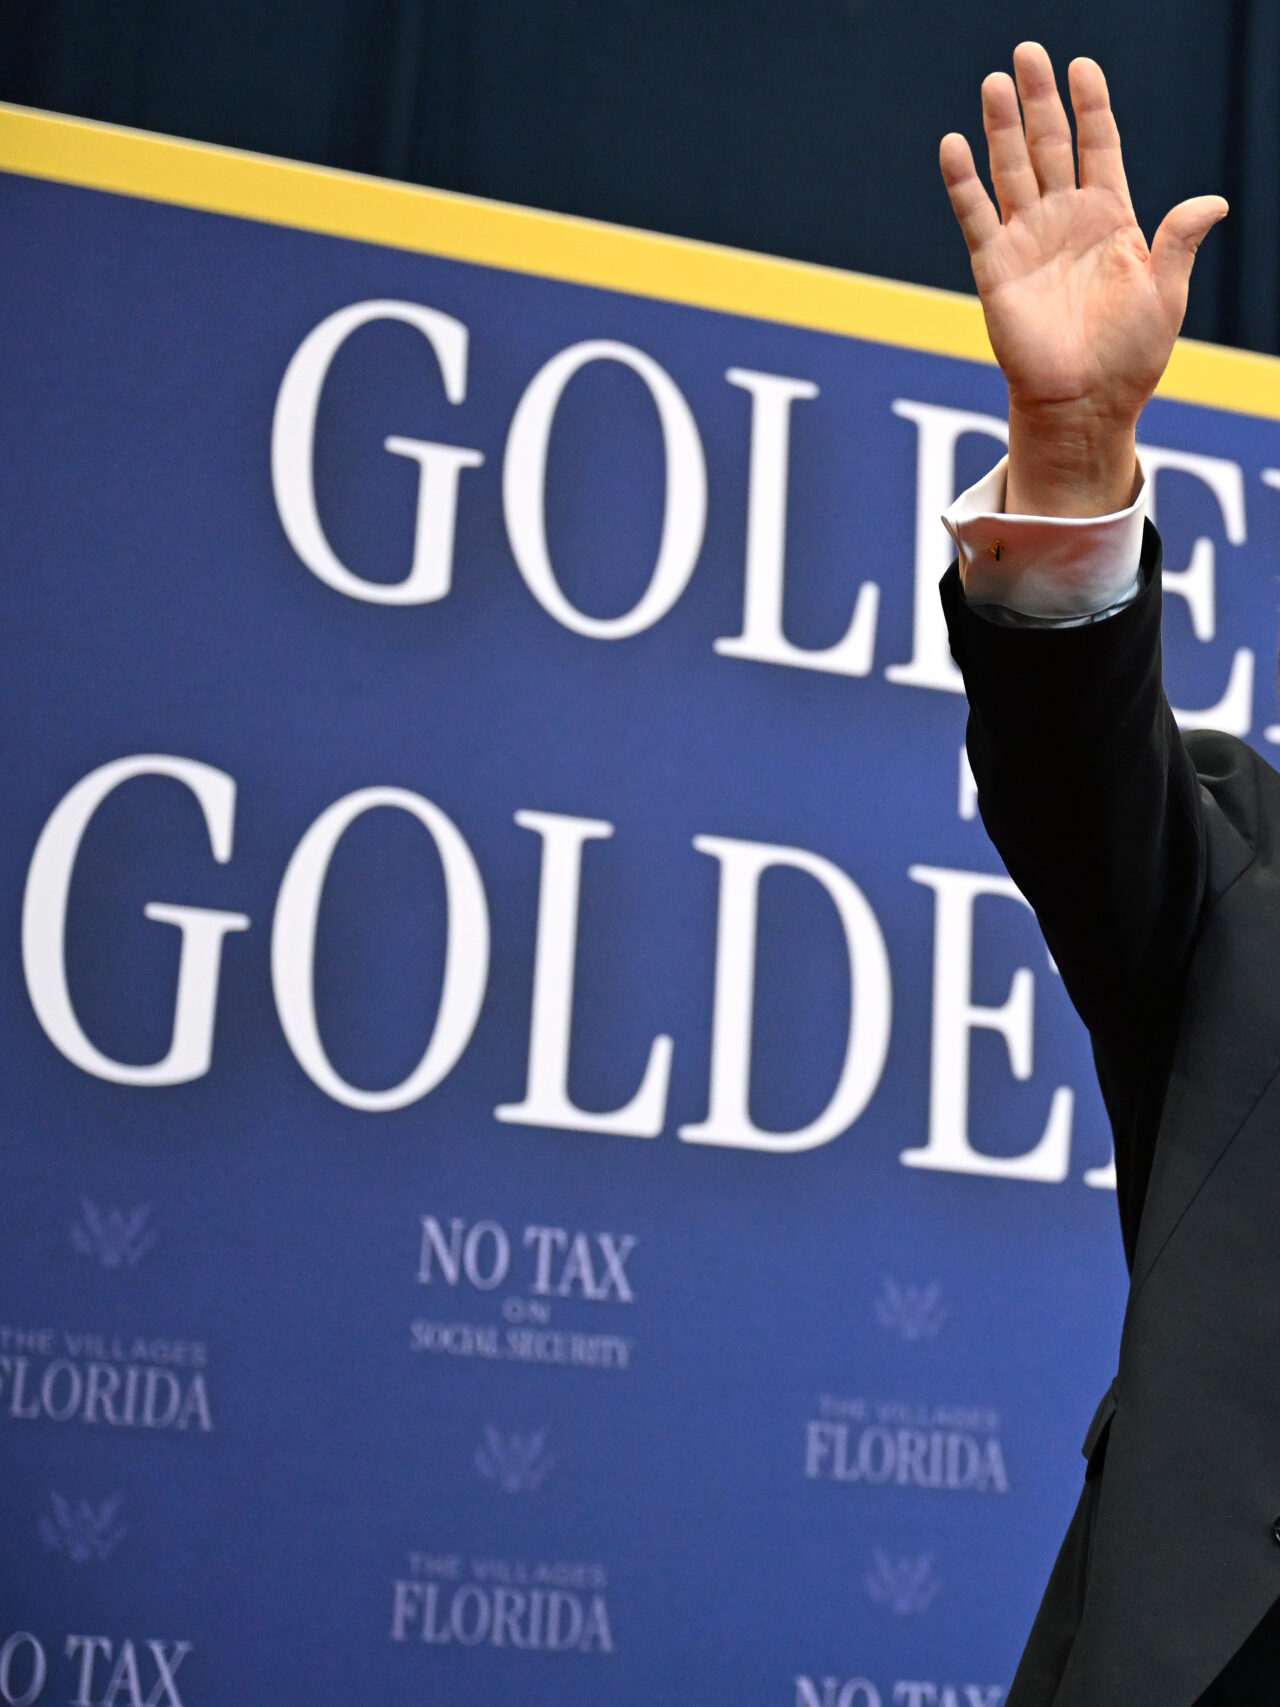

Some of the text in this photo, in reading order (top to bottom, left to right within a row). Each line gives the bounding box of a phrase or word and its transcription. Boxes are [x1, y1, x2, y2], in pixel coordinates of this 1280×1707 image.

[21, 754, 1117, 1189] GOLDE
[418, 1216, 635, 1301] NO TAX
[0, 1357, 211, 1431] LORIDA
[806, 1421, 1008, 1492] FLORIDA
[392, 1580, 614, 1653] FLORIDA
[66, 1635, 191, 1707] TAX
